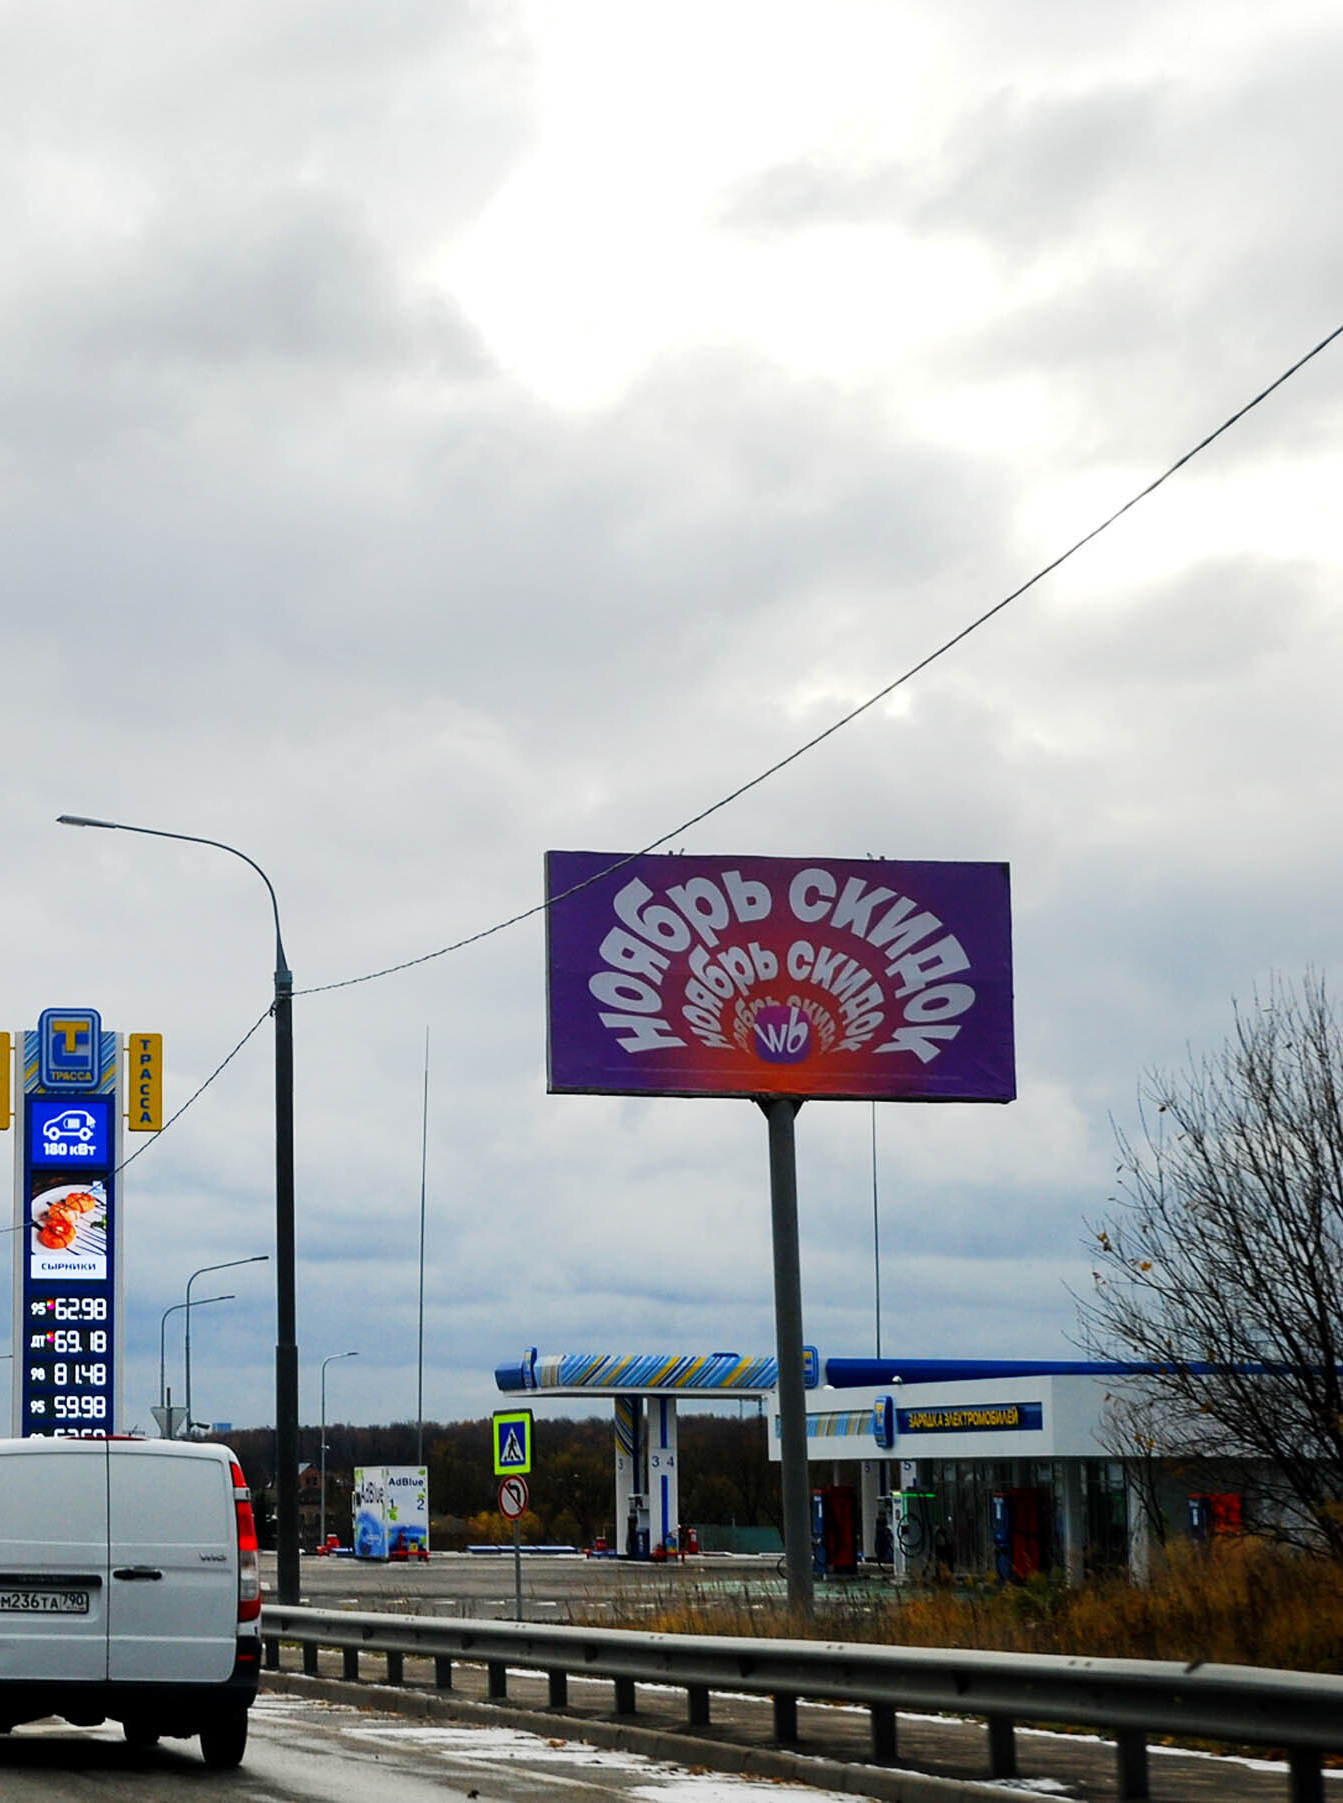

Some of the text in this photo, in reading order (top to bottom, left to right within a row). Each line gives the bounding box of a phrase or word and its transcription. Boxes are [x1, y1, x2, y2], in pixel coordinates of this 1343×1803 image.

[52, 1071, 92, 1081] ТРАССА
[140, 1039, 152, 1123] ТРАССА
[43, 1143, 96, 1156] 180 кВт
[41, 1262, 96, 1271] СЫРНИКИ
[31, 1298, 107, 1320] 95 62.98
[31, 1335, 45, 1348] ДТ
[31, 1367, 45, 1381] 98
[30, 1396, 106, 1418] 95 59.98
[909, 1405, 1019, 1428] ЗАРЯДКА ЭЛЕКТРОМОБИЛЕЙ
[652, 1455, 674, 1468] 3 4
[388, 1477, 424, 1486] AdBlue
[417, 1498, 425, 1510] 2
